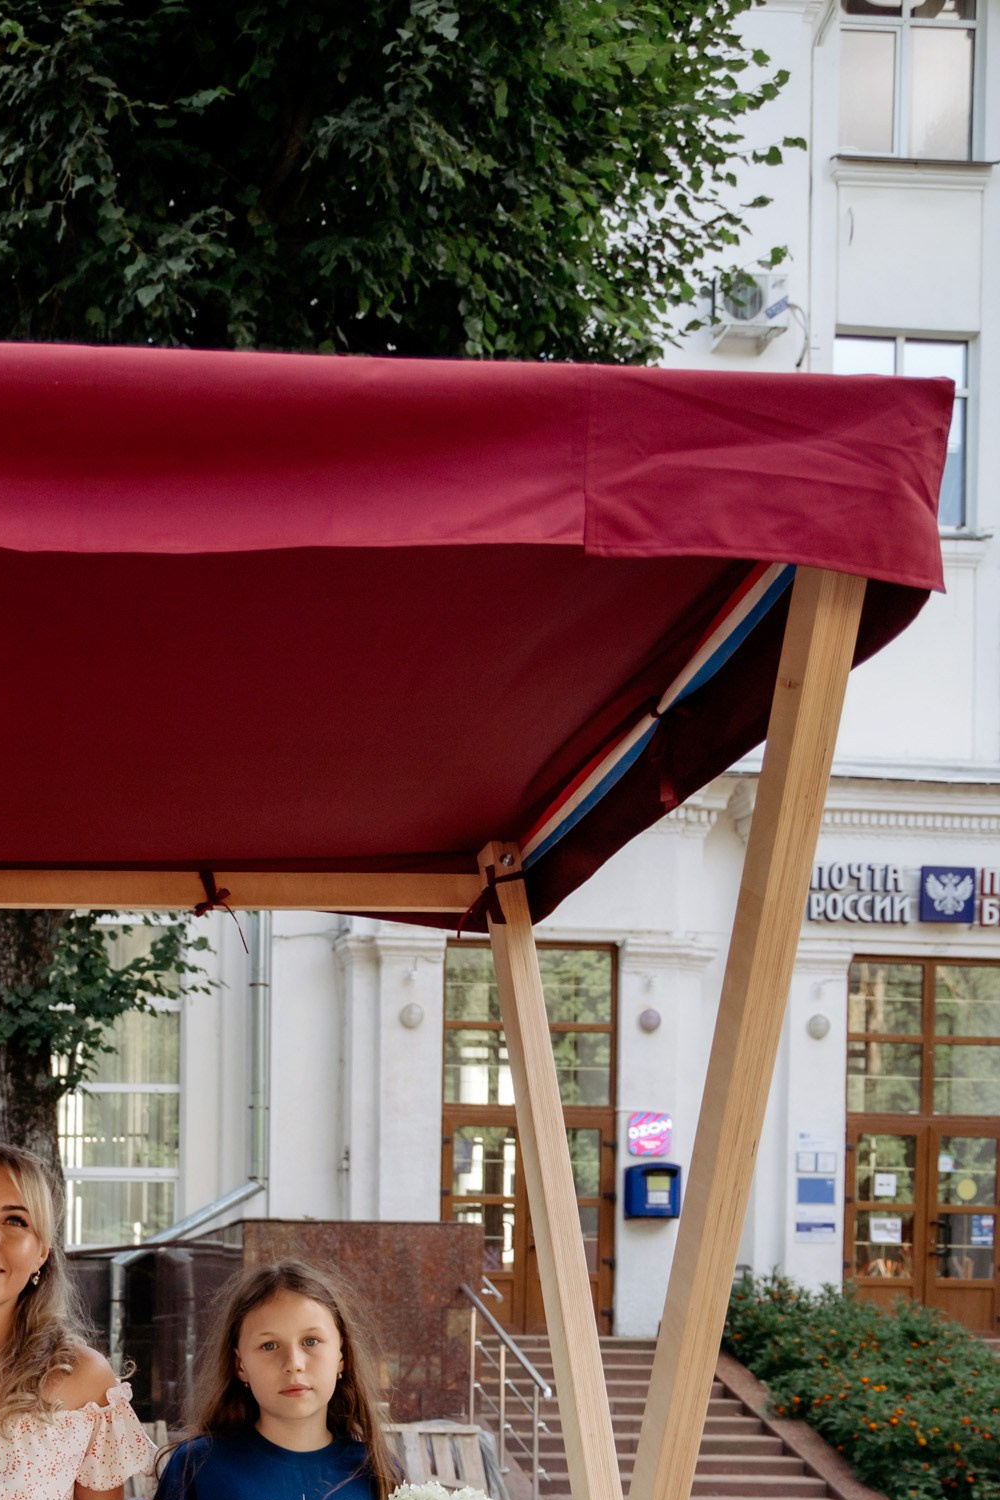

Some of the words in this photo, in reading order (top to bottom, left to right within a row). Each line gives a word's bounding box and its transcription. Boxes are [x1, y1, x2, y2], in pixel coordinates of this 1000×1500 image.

[810, 863, 904, 892] ПОЧТА
[808, 893, 911, 924] РОССИИ
[628, 1119, 672, 1140] OZON
